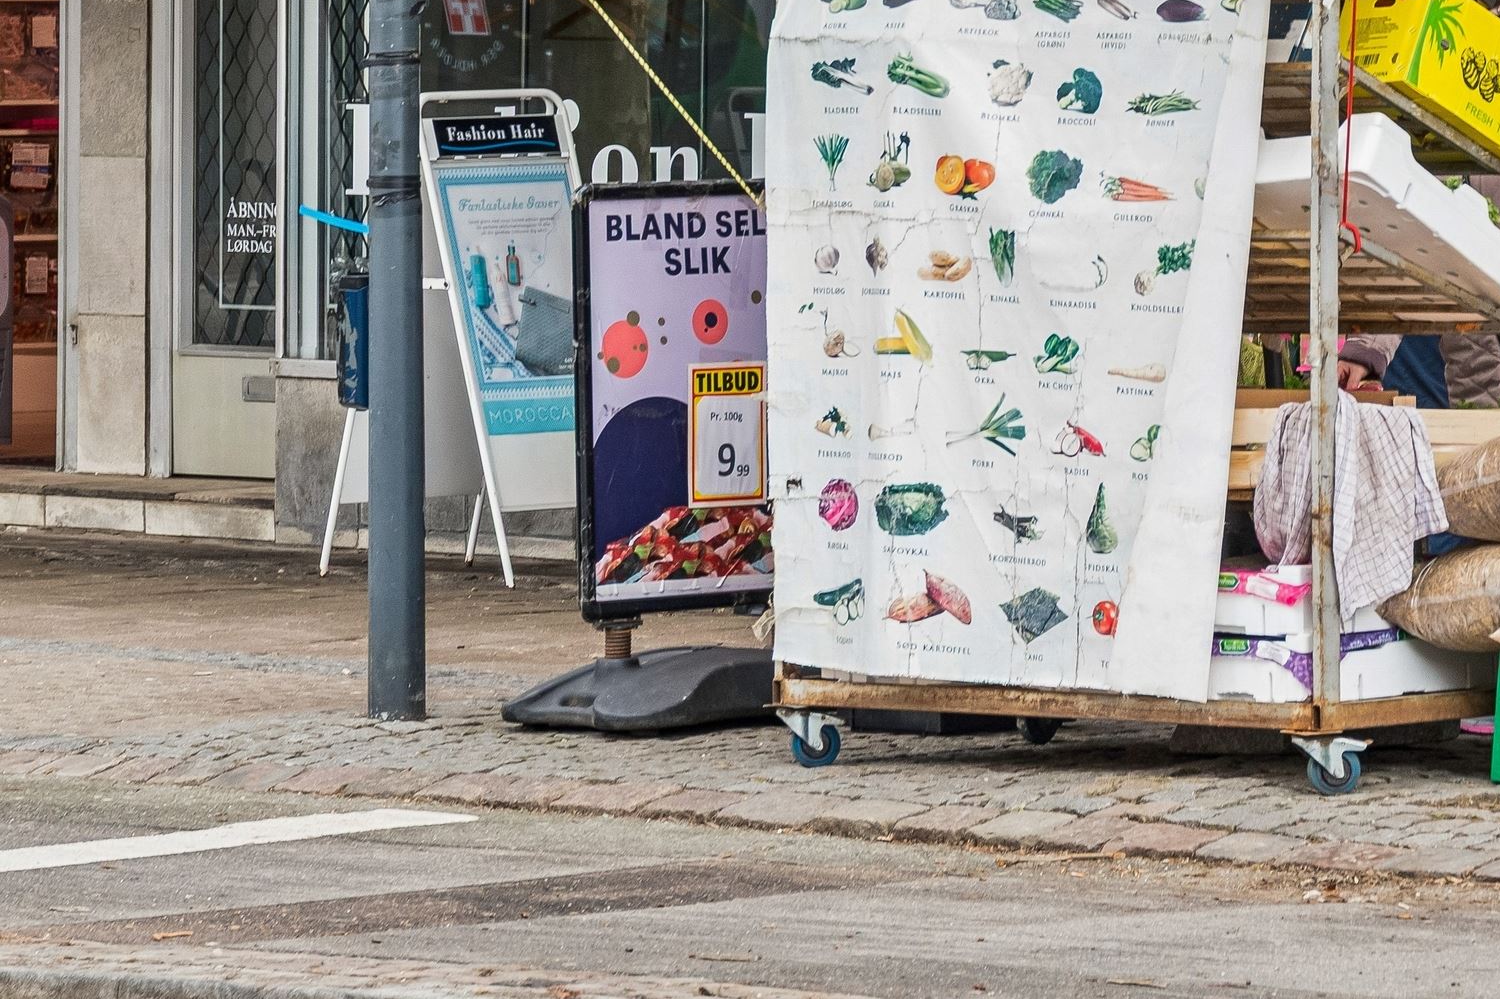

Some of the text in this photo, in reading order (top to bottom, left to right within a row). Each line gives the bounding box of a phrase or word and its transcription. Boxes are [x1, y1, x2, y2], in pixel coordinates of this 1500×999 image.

[1034, 31, 1071, 40] ASPARGES
[1096, 31, 1132, 40] ASPARGES
[893, 106, 942, 116] BLADSELLERI
[1465, 102, 1494, 128] FRESH
[1057, 117, 1097, 126] BROCCOLI
[1146, 119, 1175, 128] BØNNER
[447, 121, 545, 141] Fashion Hair
[1113, 213, 1153, 223] GULEROD
[606, 211, 707, 242] BLAND
[227, 239, 272, 254] LØRDAG
[664, 246, 731, 276] SLIK
[813, 287, 846, 295] HVIDLØG
[923, 289, 966, 300] KARTOFFEL
[989, 294, 1020, 304] KINAKÅL
[1049, 299, 1098, 309] KINARADISE
[821, 368, 849, 376] MAJROE
[880, 370, 902, 379] MAJS
[695, 371, 759, 393] TILBUD
[974, 375, 996, 384] OKRA
[1038, 381, 1073, 391] PAK CHOY
[1116, 386, 1154, 397] PASTINAK
[723, 411, 743, 423] 100g
[717, 443, 750, 477] 9 99
[971, 459, 994, 468] PORRE
[1064, 467, 1089, 476] RADISE
[882, 545, 929, 557] SAVOYKÅL
[896, 641, 972, 656] SØD KARTOFFEL
